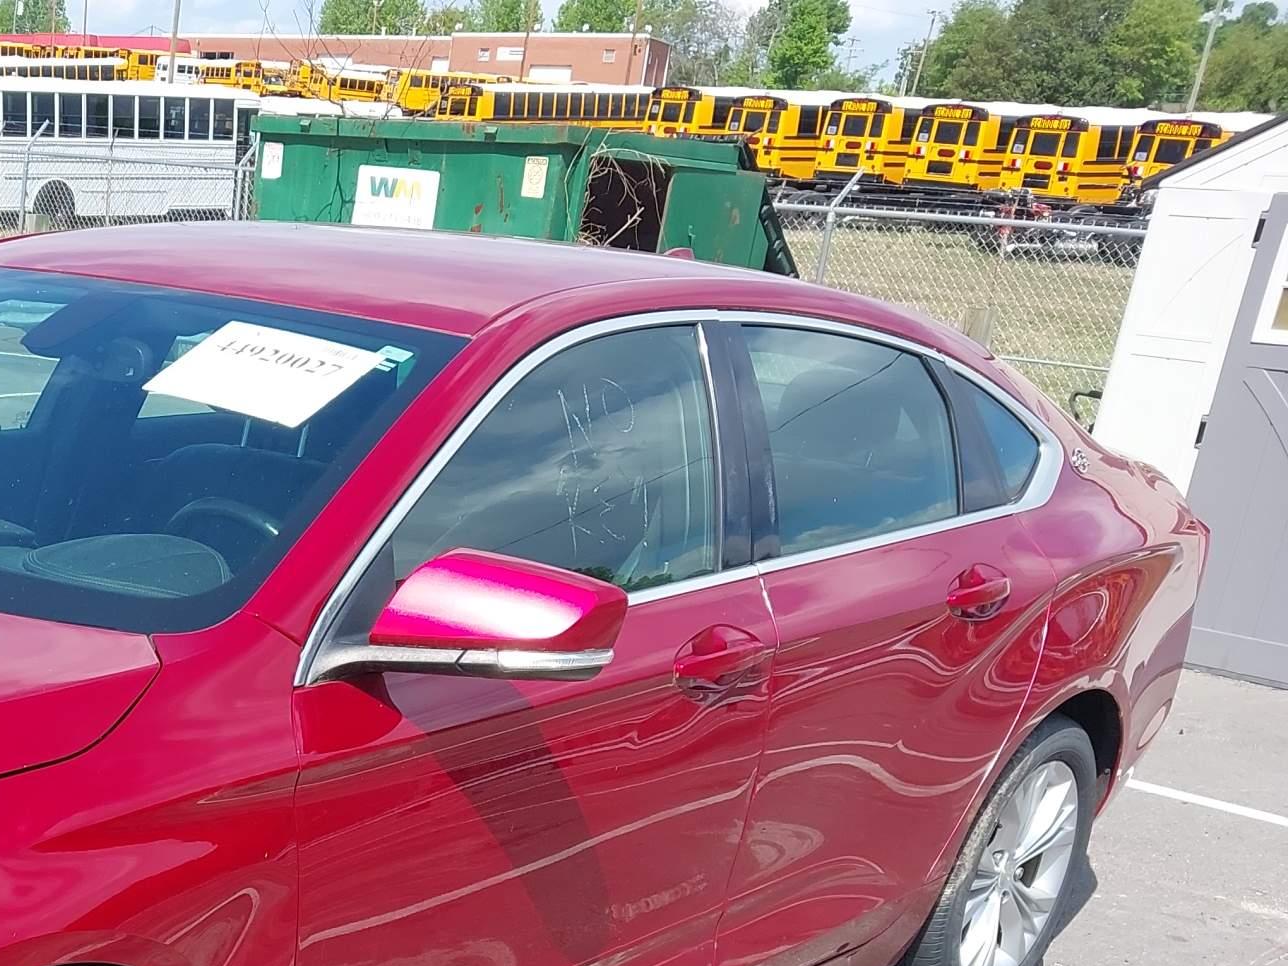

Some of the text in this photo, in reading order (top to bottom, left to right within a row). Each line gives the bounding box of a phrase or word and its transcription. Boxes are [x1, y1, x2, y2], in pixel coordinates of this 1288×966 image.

[1158, 123, 1183, 134] SCHOOL
[370, 176, 421, 200] WM
[217, 340, 344, 376] 44920027
[557, 378, 634, 467] NO
